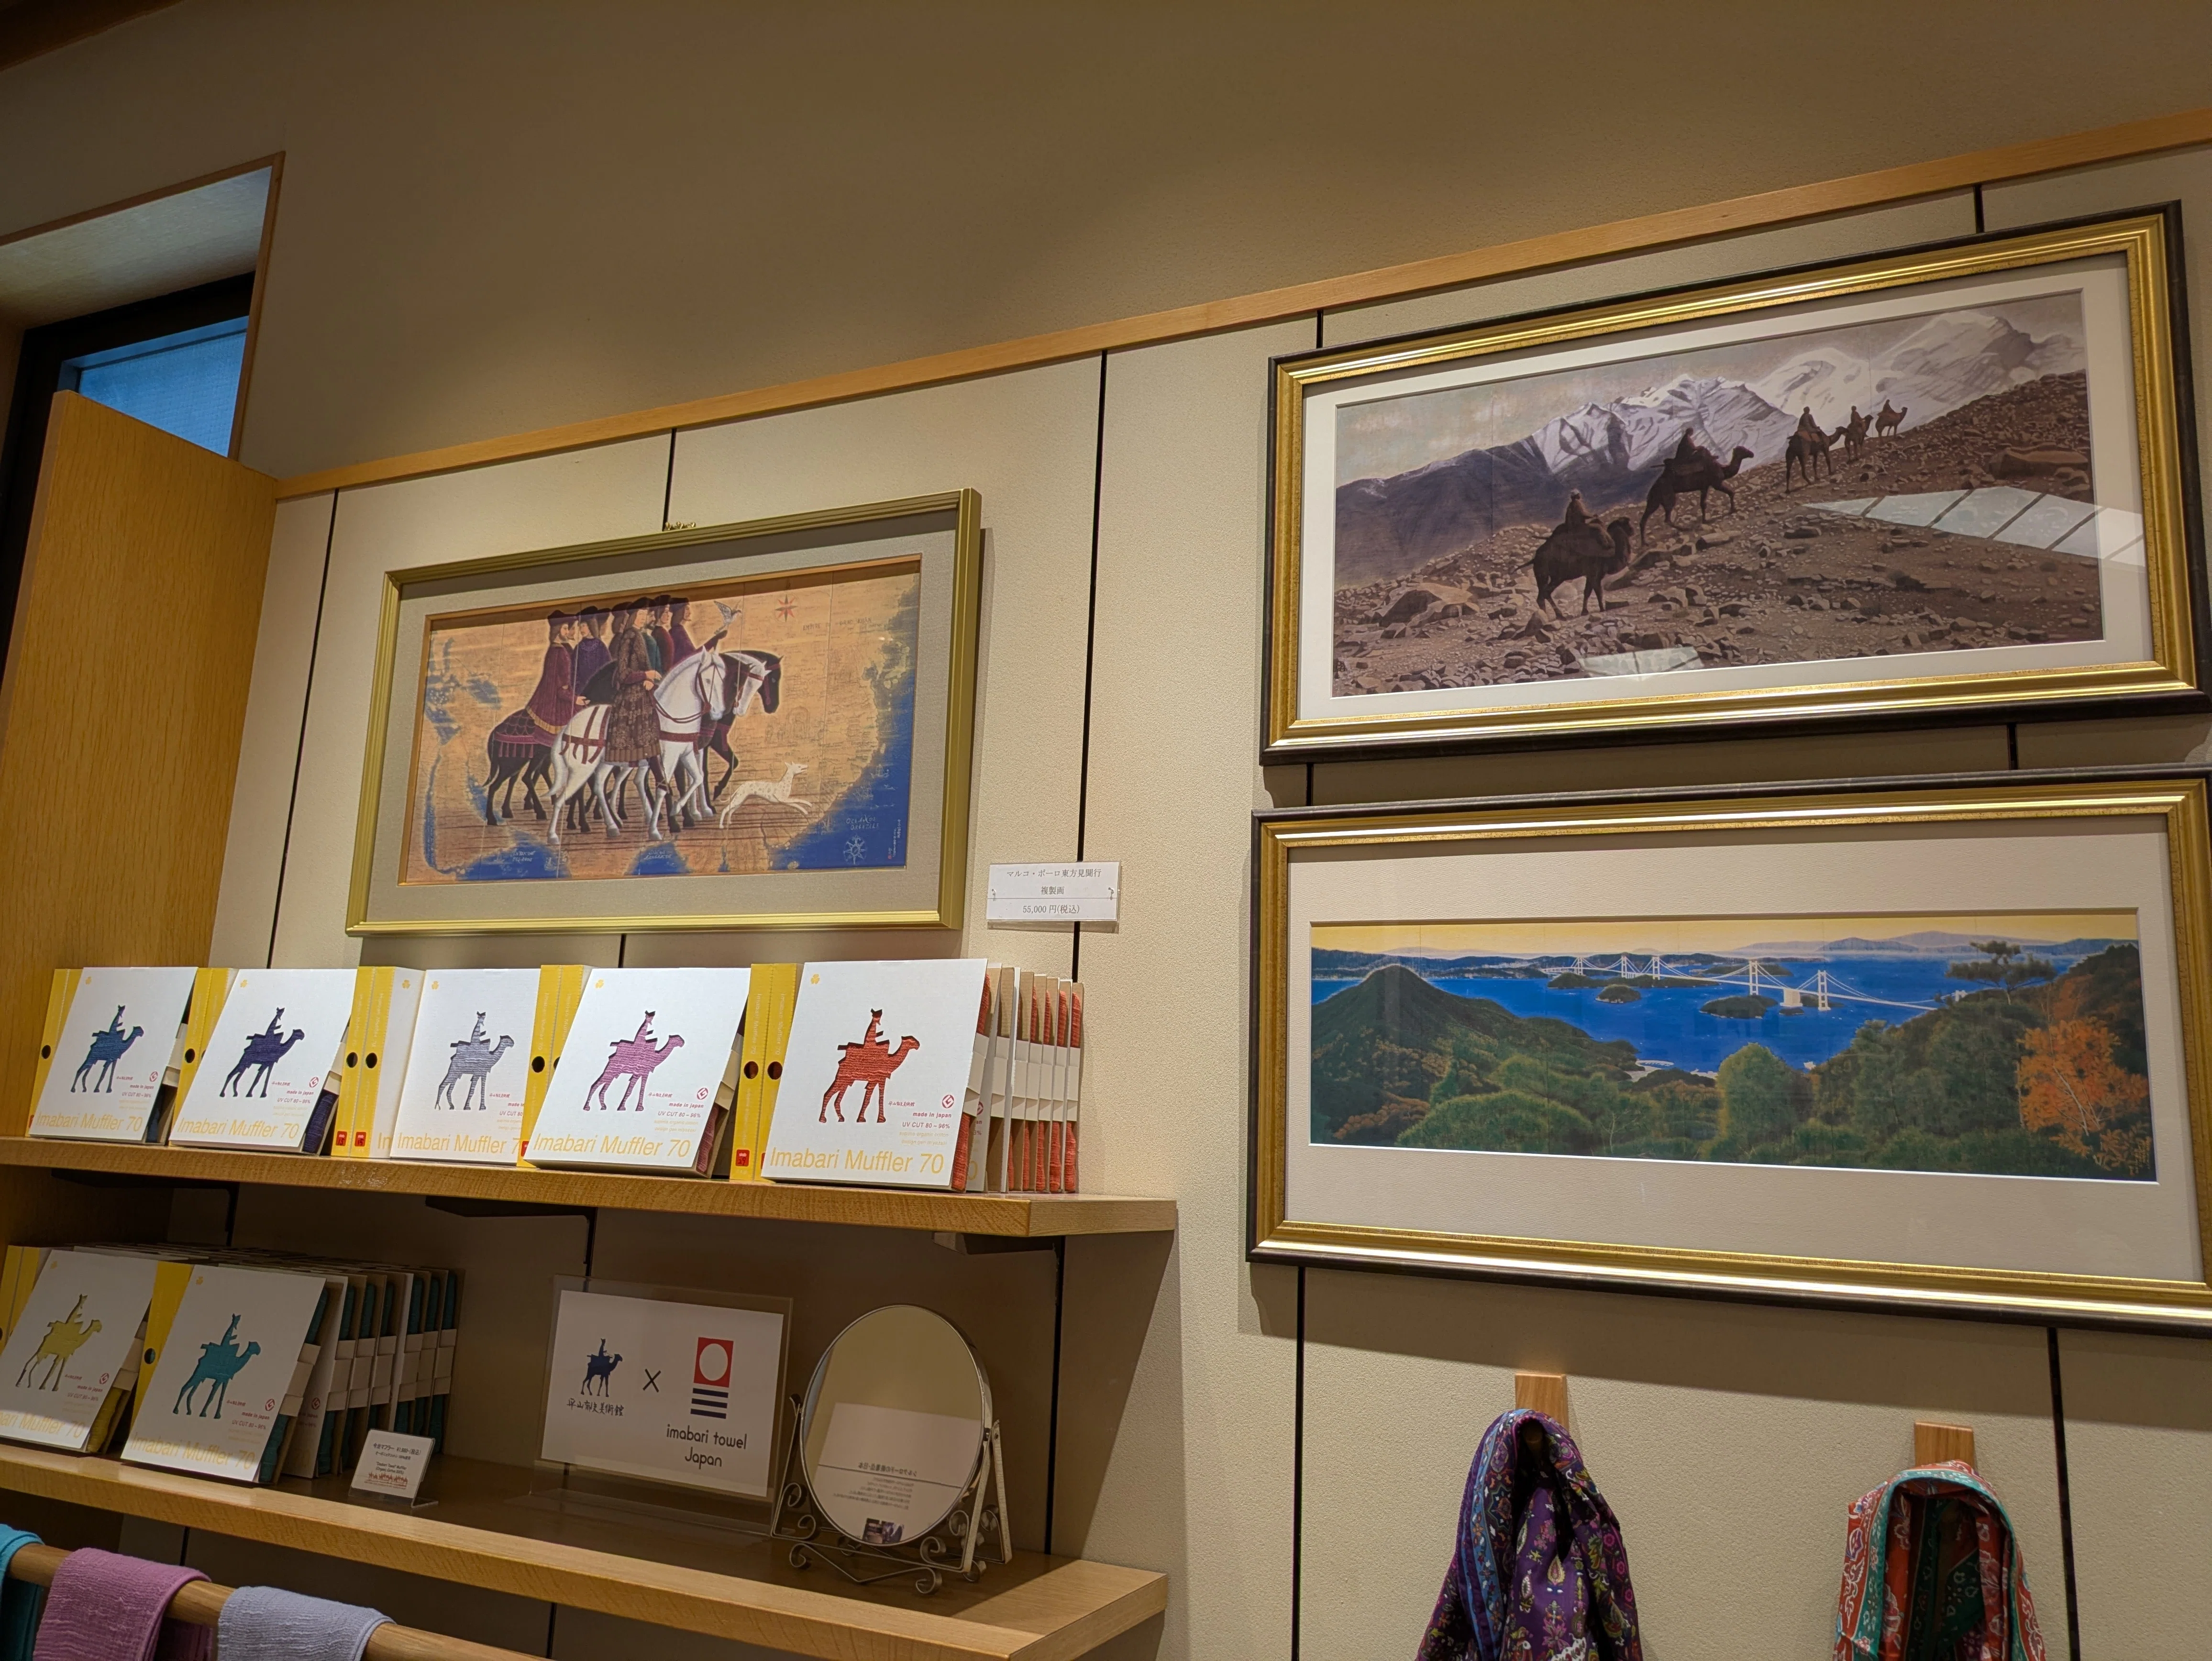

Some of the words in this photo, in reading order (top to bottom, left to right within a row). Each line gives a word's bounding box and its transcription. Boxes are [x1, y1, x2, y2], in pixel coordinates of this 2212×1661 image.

[1006, 869, 1102, 878] マルコ・ポーロ東方見聞行
[1040, 886, 1065, 895] 複製画
[1023, 905, 1047, 914] 55,000
[35, 1112, 80, 1128] Imabari
[80, 1113, 124, 1130] Muffler
[126, 1116, 143, 1132] 70
[177, 1118, 228, 1134] Imabari
[228, 1119, 278, 1138] Muffler
[280, 1123, 299, 1139] 70
[398, 1132, 450, 1151] Imabari
[453, 1134, 507, 1154] Muffler
[533, 1133, 598, 1152] Imabari
[599, 1135, 664, 1156] Muffler
[667, 1139, 691, 1158] 70
[769, 1147, 840, 1169] Imabari
[844, 1150, 913, 1173] Muffler
[919, 1153, 944, 1174] 70
[567, 1397, 625, 1417] 平山郁夫美術館
[18, 1412, 66, 1435] Muffler
[66, 1420, 85, 1439] 70
[666, 1423, 709, 1443] imabari
[713, 1431, 747, 1450] towel
[131, 1432, 182, 1457] Imabari
[182, 1440, 233, 1466] Muffler
[235, 1449, 255, 1470] 70
[685, 1446, 722, 1470] Japan
